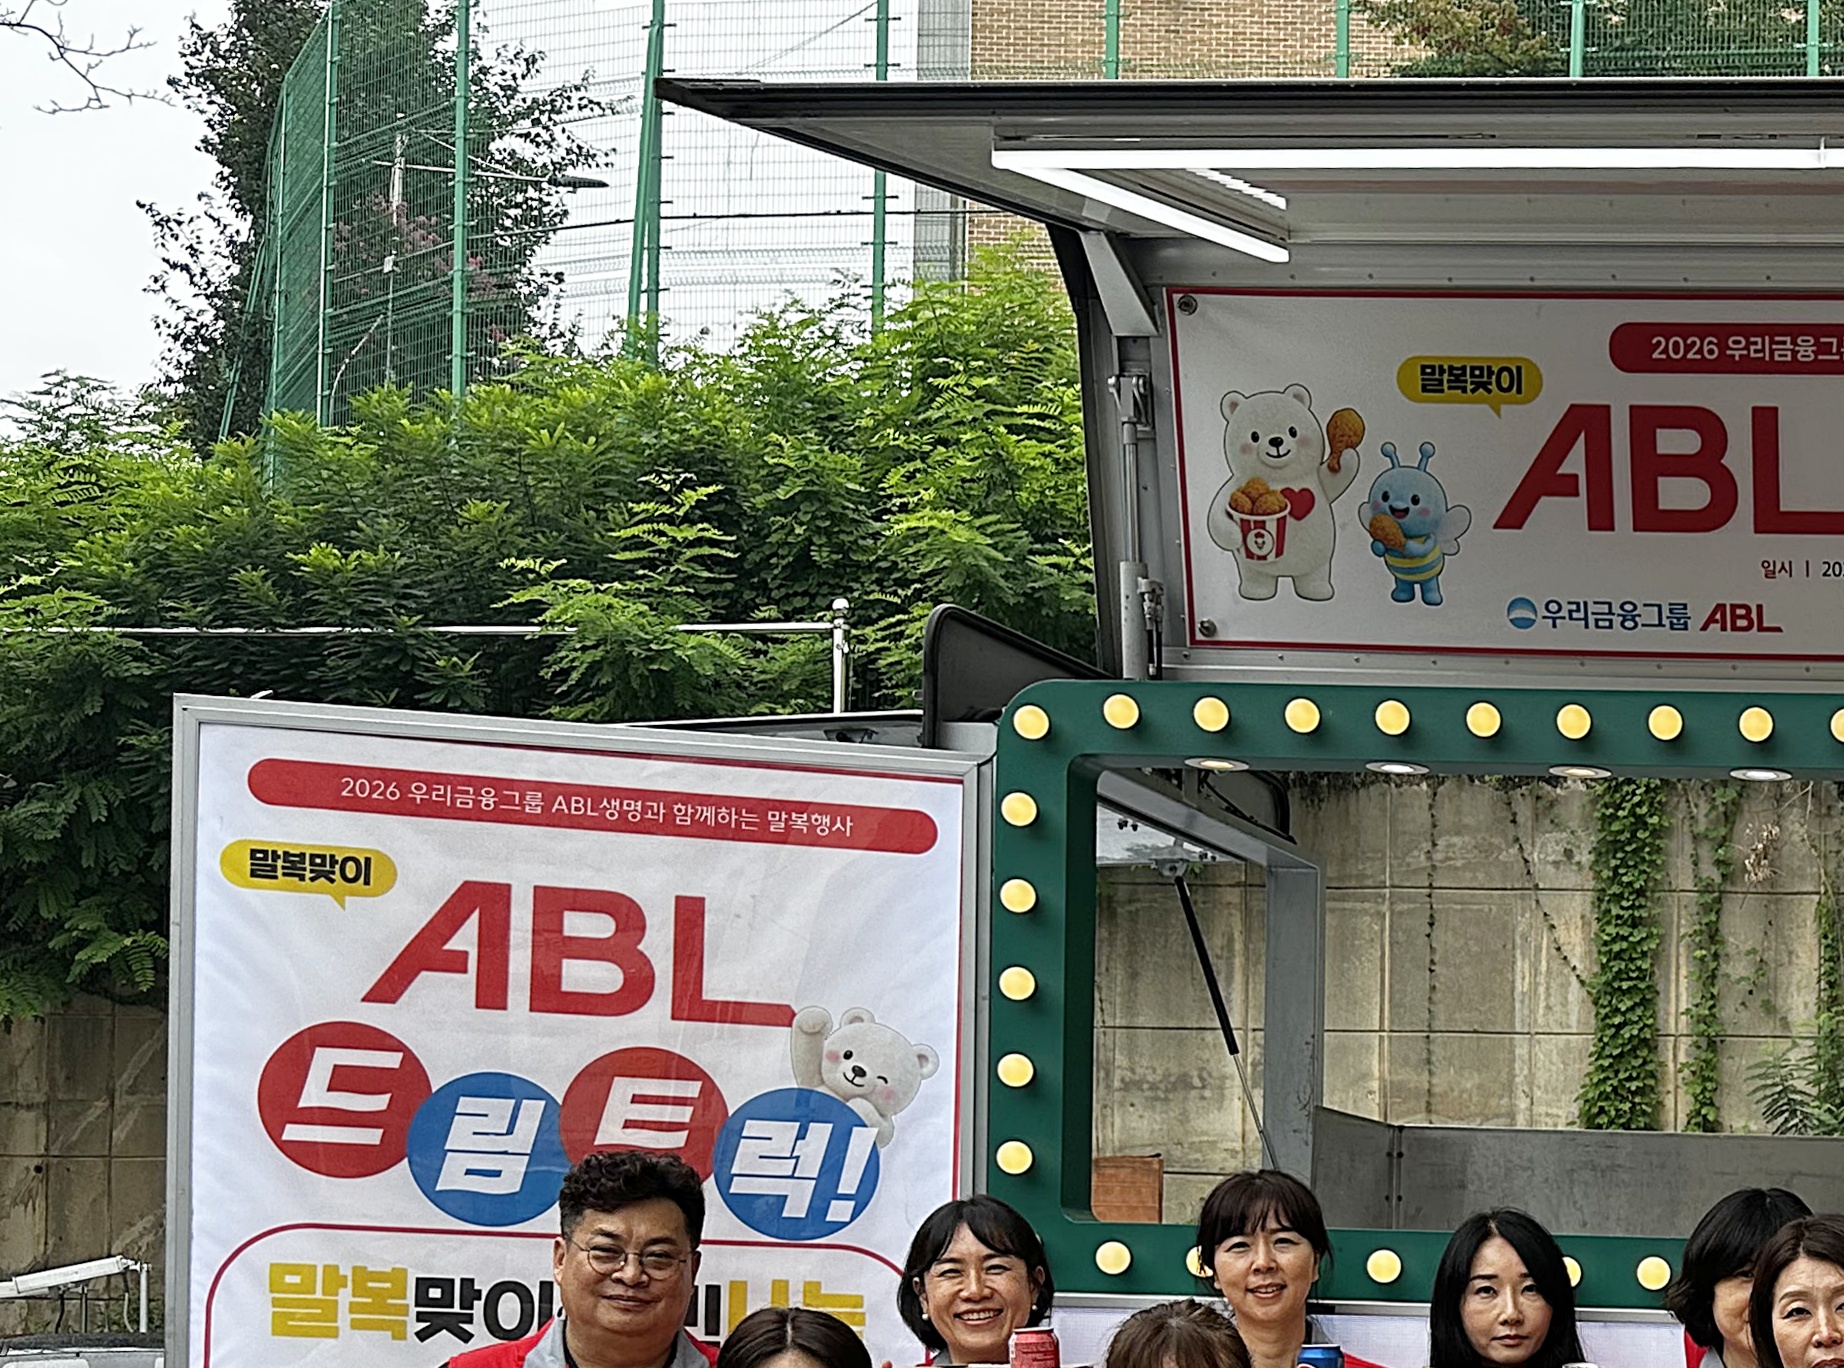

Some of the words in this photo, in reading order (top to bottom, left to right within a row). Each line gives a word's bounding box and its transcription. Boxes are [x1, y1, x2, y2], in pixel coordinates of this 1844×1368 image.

[1651, 336, 1718, 360] 2026
[1419, 363, 1524, 396] 말복맞이
[1761, 560, 1793, 579] 일시
[1541, 598, 1692, 632] 우리금융그룹
[1700, 603, 1784, 633] ABL
[340, 775, 402, 801] 2026
[407, 781, 545, 816] 우리금융그룹
[551, 793, 666, 824] ABL생명과
[673, 798, 760, 831] 함께하는
[766, 804, 854, 838] 말복행사
[248, 846, 372, 888] 말복맞이
[361, 879, 796, 1028] ABL
